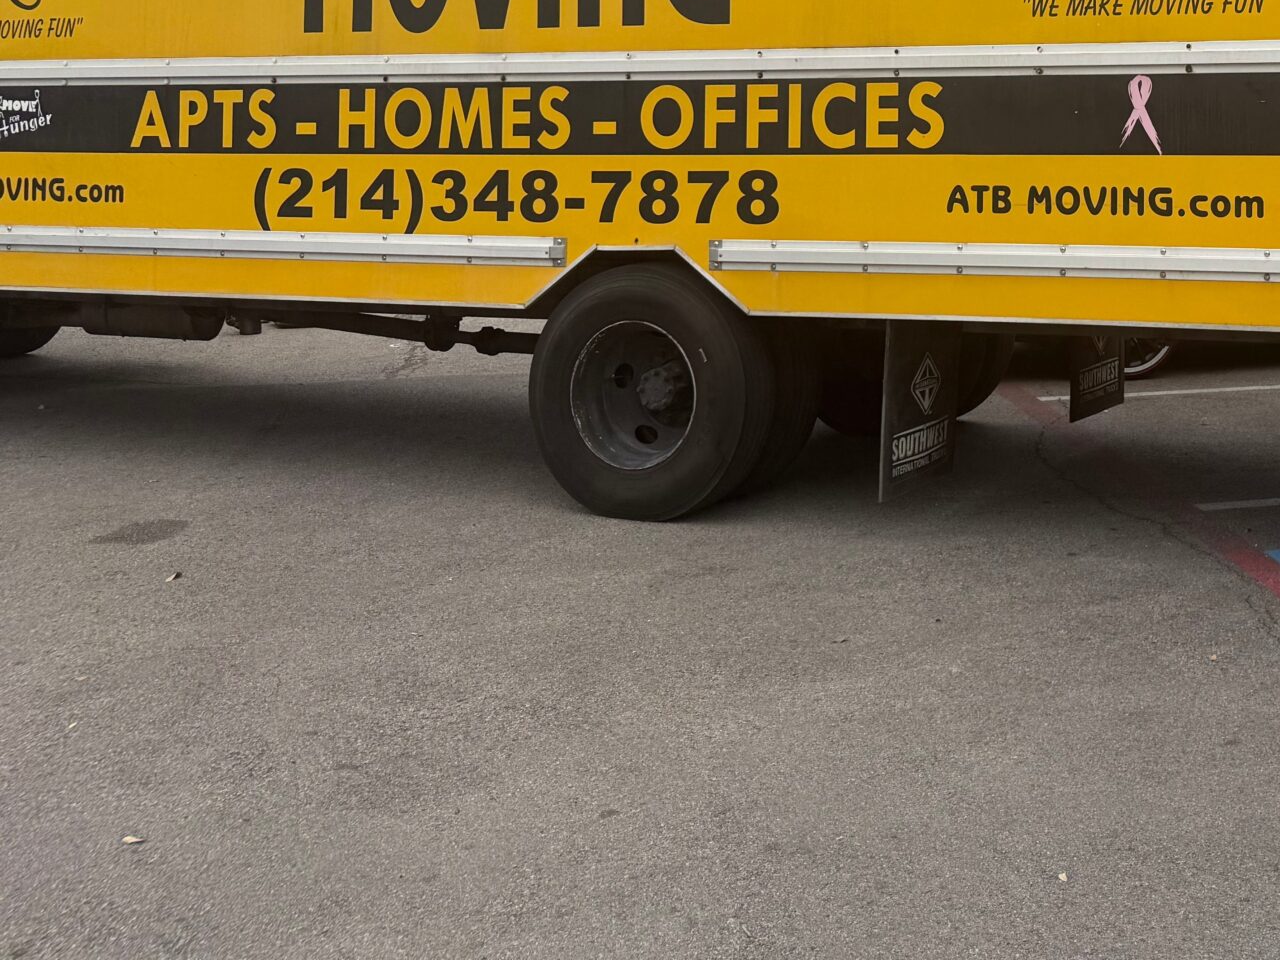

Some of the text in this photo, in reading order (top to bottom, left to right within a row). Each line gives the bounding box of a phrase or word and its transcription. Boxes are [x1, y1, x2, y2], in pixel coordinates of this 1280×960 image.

[0, 17, 84, 39] OVING FUN"
[9, 115, 20, 123] FOR
[130, 87, 277, 149] APTS
[337, 86, 572, 150] HOMES
[639, 82, 946, 150] OFFICES
[0, 177, 124, 203] VING.com
[253, 167, 780, 234] (214)348-7878
[946, 184, 1264, 219] ATB MOVING.com
[892, 419, 949, 462] SOUTHWEST
